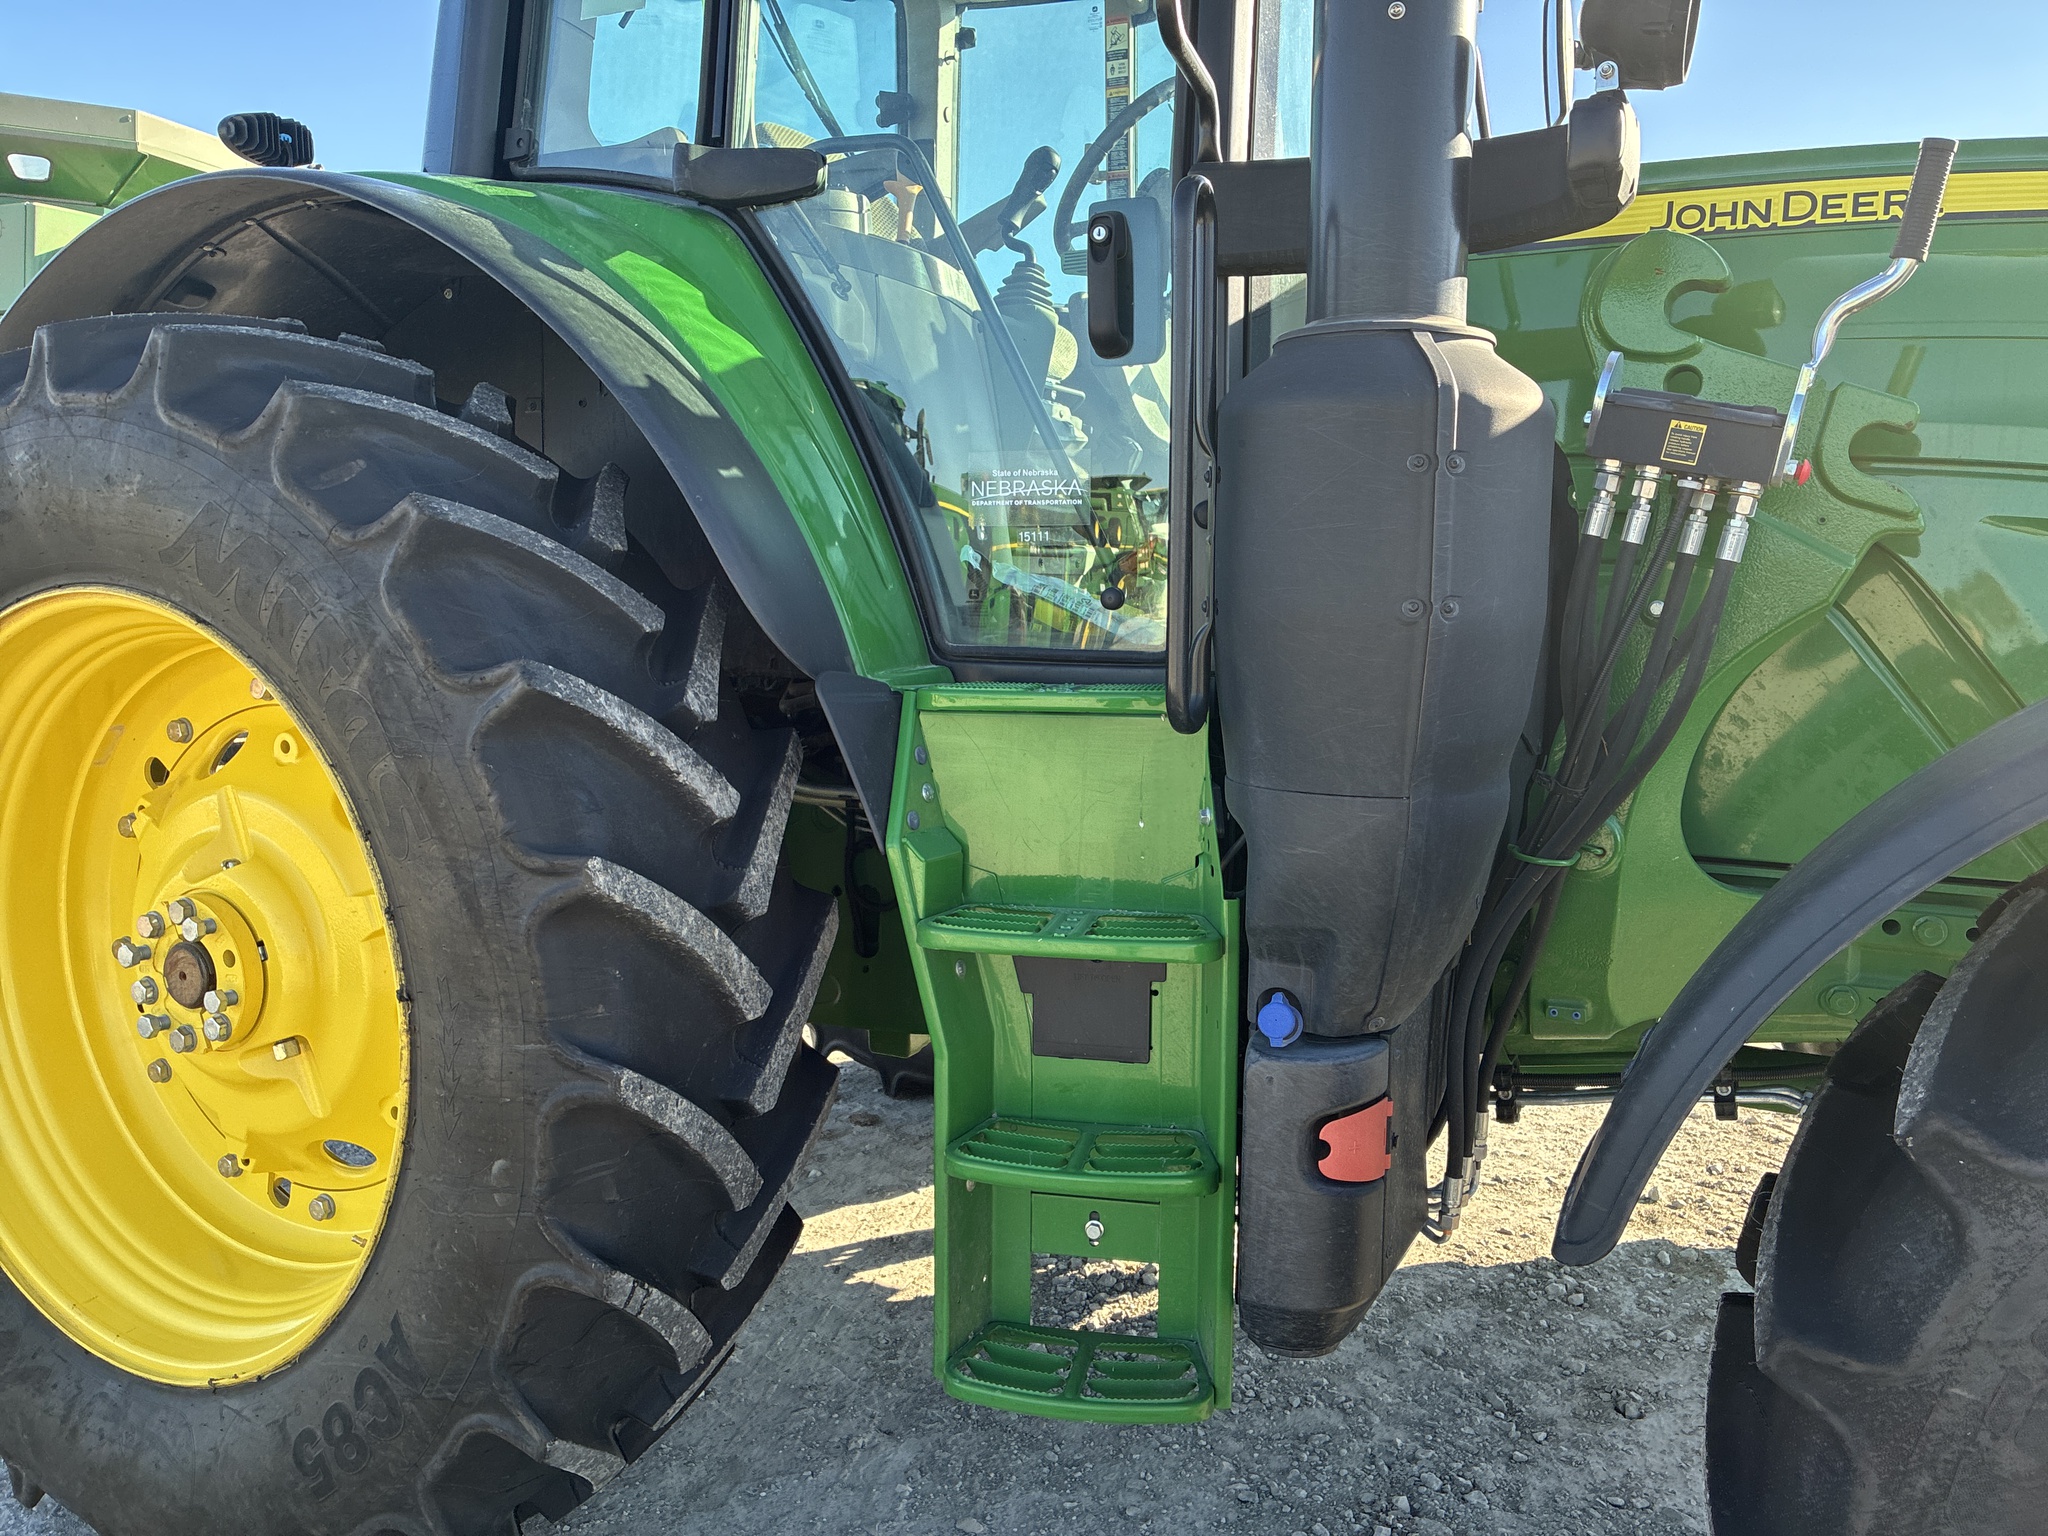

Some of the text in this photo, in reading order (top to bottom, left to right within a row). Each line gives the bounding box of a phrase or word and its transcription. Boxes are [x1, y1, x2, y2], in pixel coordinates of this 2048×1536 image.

[1650, 188, 1943, 230] JOHN DEER
[992, 468, 1059, 477] State of Nebraska
[971, 479, 1082, 497] NEBRASKA
[1024, 498, 1083, 506] TRANSPORTATION
[1019, 530, 1049, 542] 15111
[292, 1310, 430, 1502] AC85
